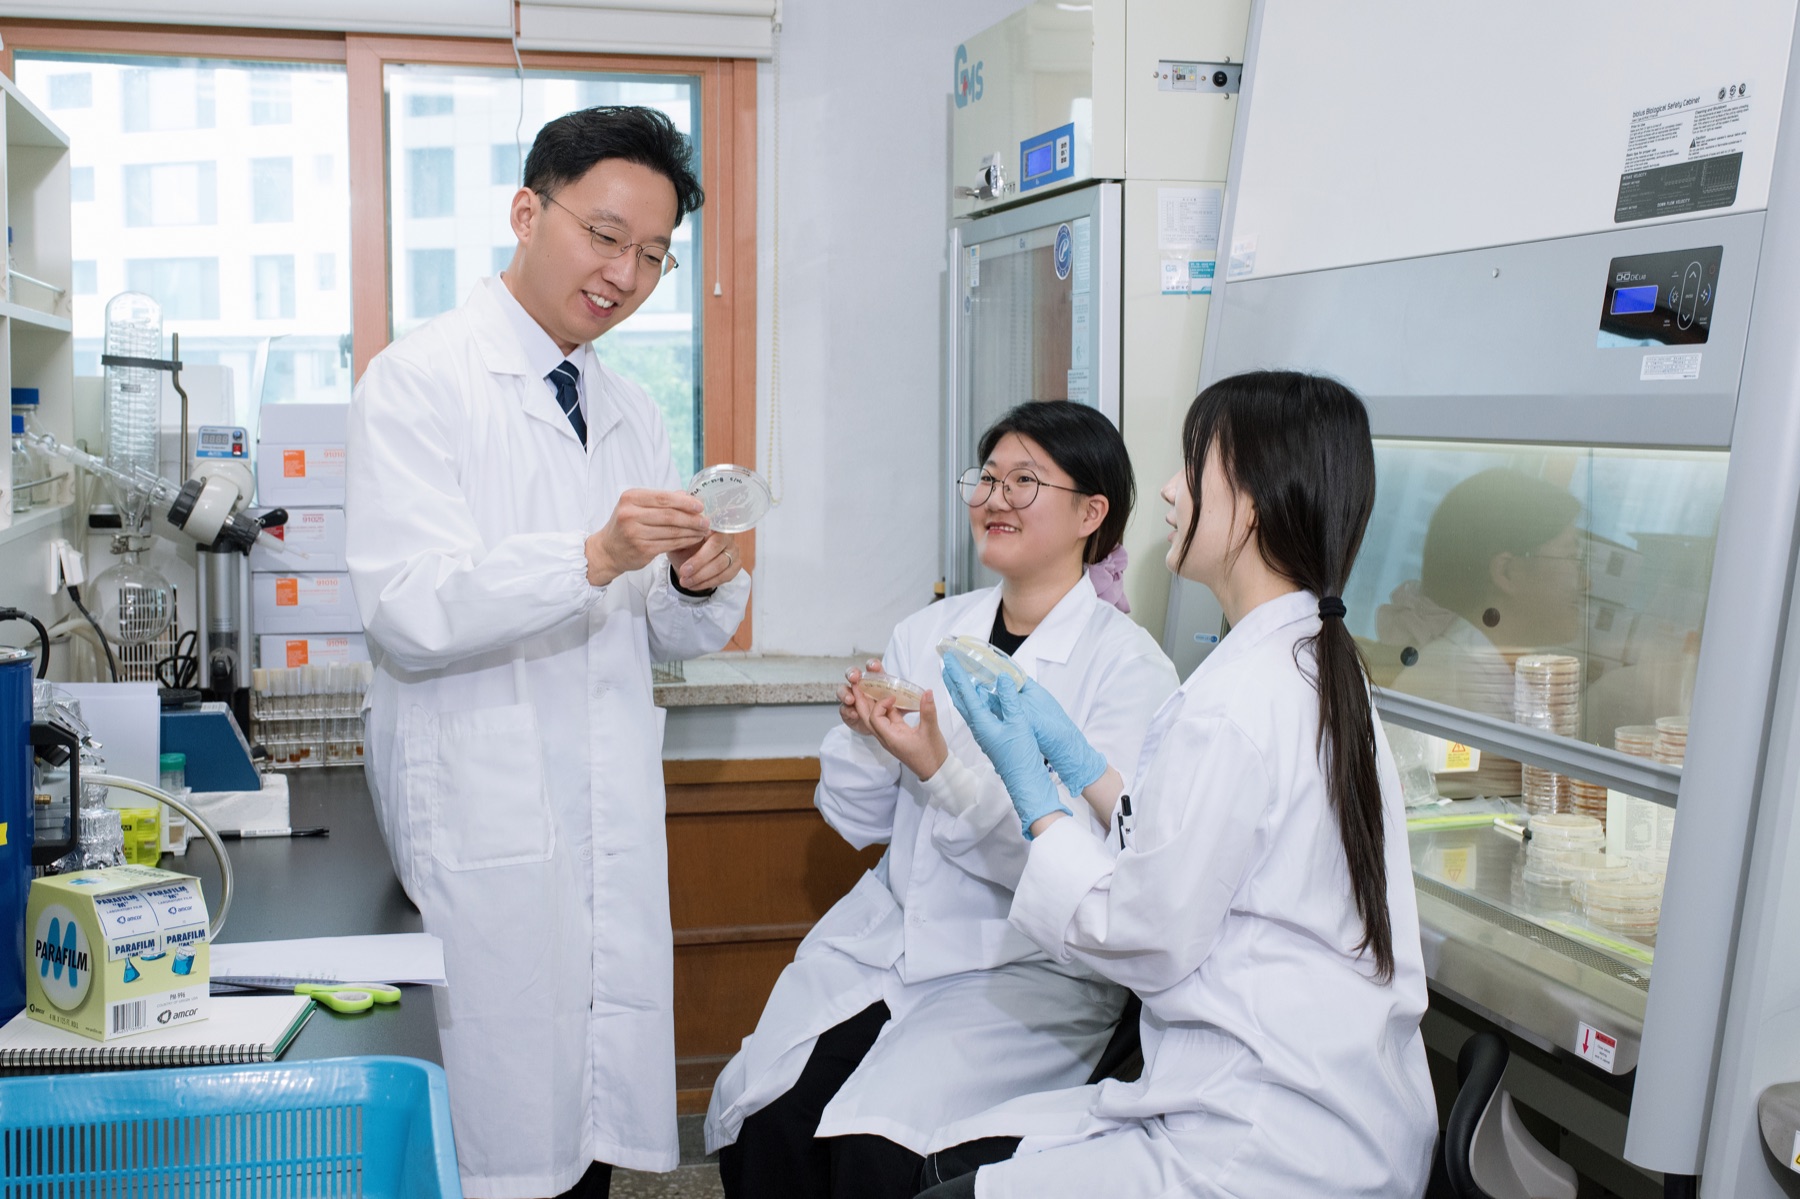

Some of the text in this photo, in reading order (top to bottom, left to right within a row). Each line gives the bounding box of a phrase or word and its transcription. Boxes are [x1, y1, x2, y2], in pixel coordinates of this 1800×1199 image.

[1646, 104, 1667, 116] Biological
[1667, 101, 1682, 110] Safety
[1683, 96, 1701, 106] Cabinet
[147, 885, 187, 897] PARAFILM
[96, 894, 138, 905] PARAFILM
[178, 905, 192, 913] amcor
[166, 928, 206, 945] PARAFILM
[115, 938, 155, 955] PARAFILM
[35, 939, 88, 972] PARAFILM
[172, 1007, 198, 1020] amcor
